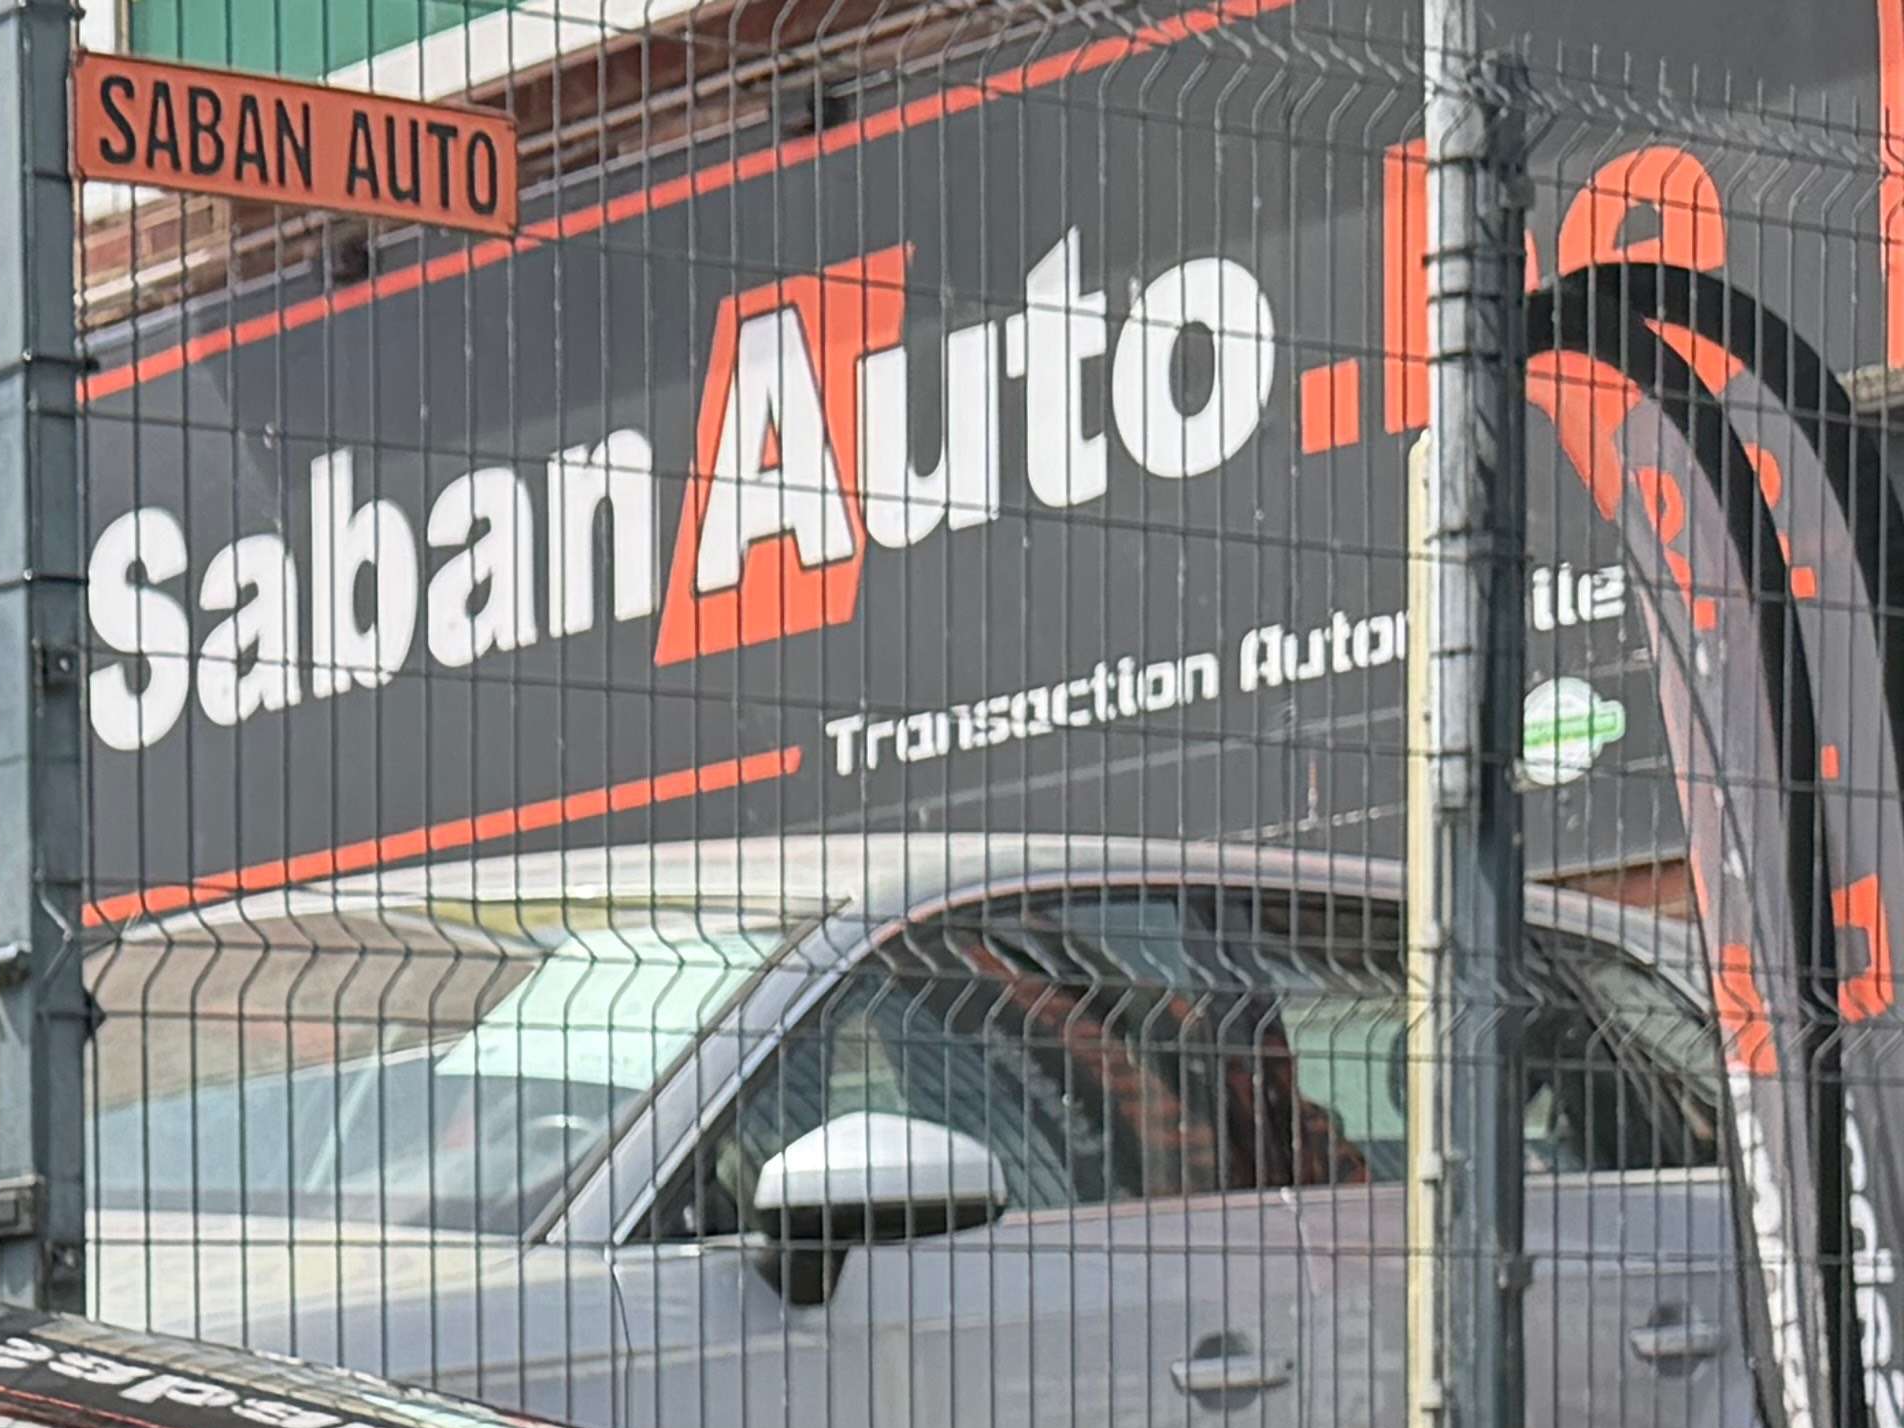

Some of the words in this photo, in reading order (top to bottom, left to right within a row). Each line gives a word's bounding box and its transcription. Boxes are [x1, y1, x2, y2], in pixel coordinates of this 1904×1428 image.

[98, 75, 313, 190] SABAN
[345, 110, 498, 214] AUTO
[824, 650, 1219, 777] Transaction
